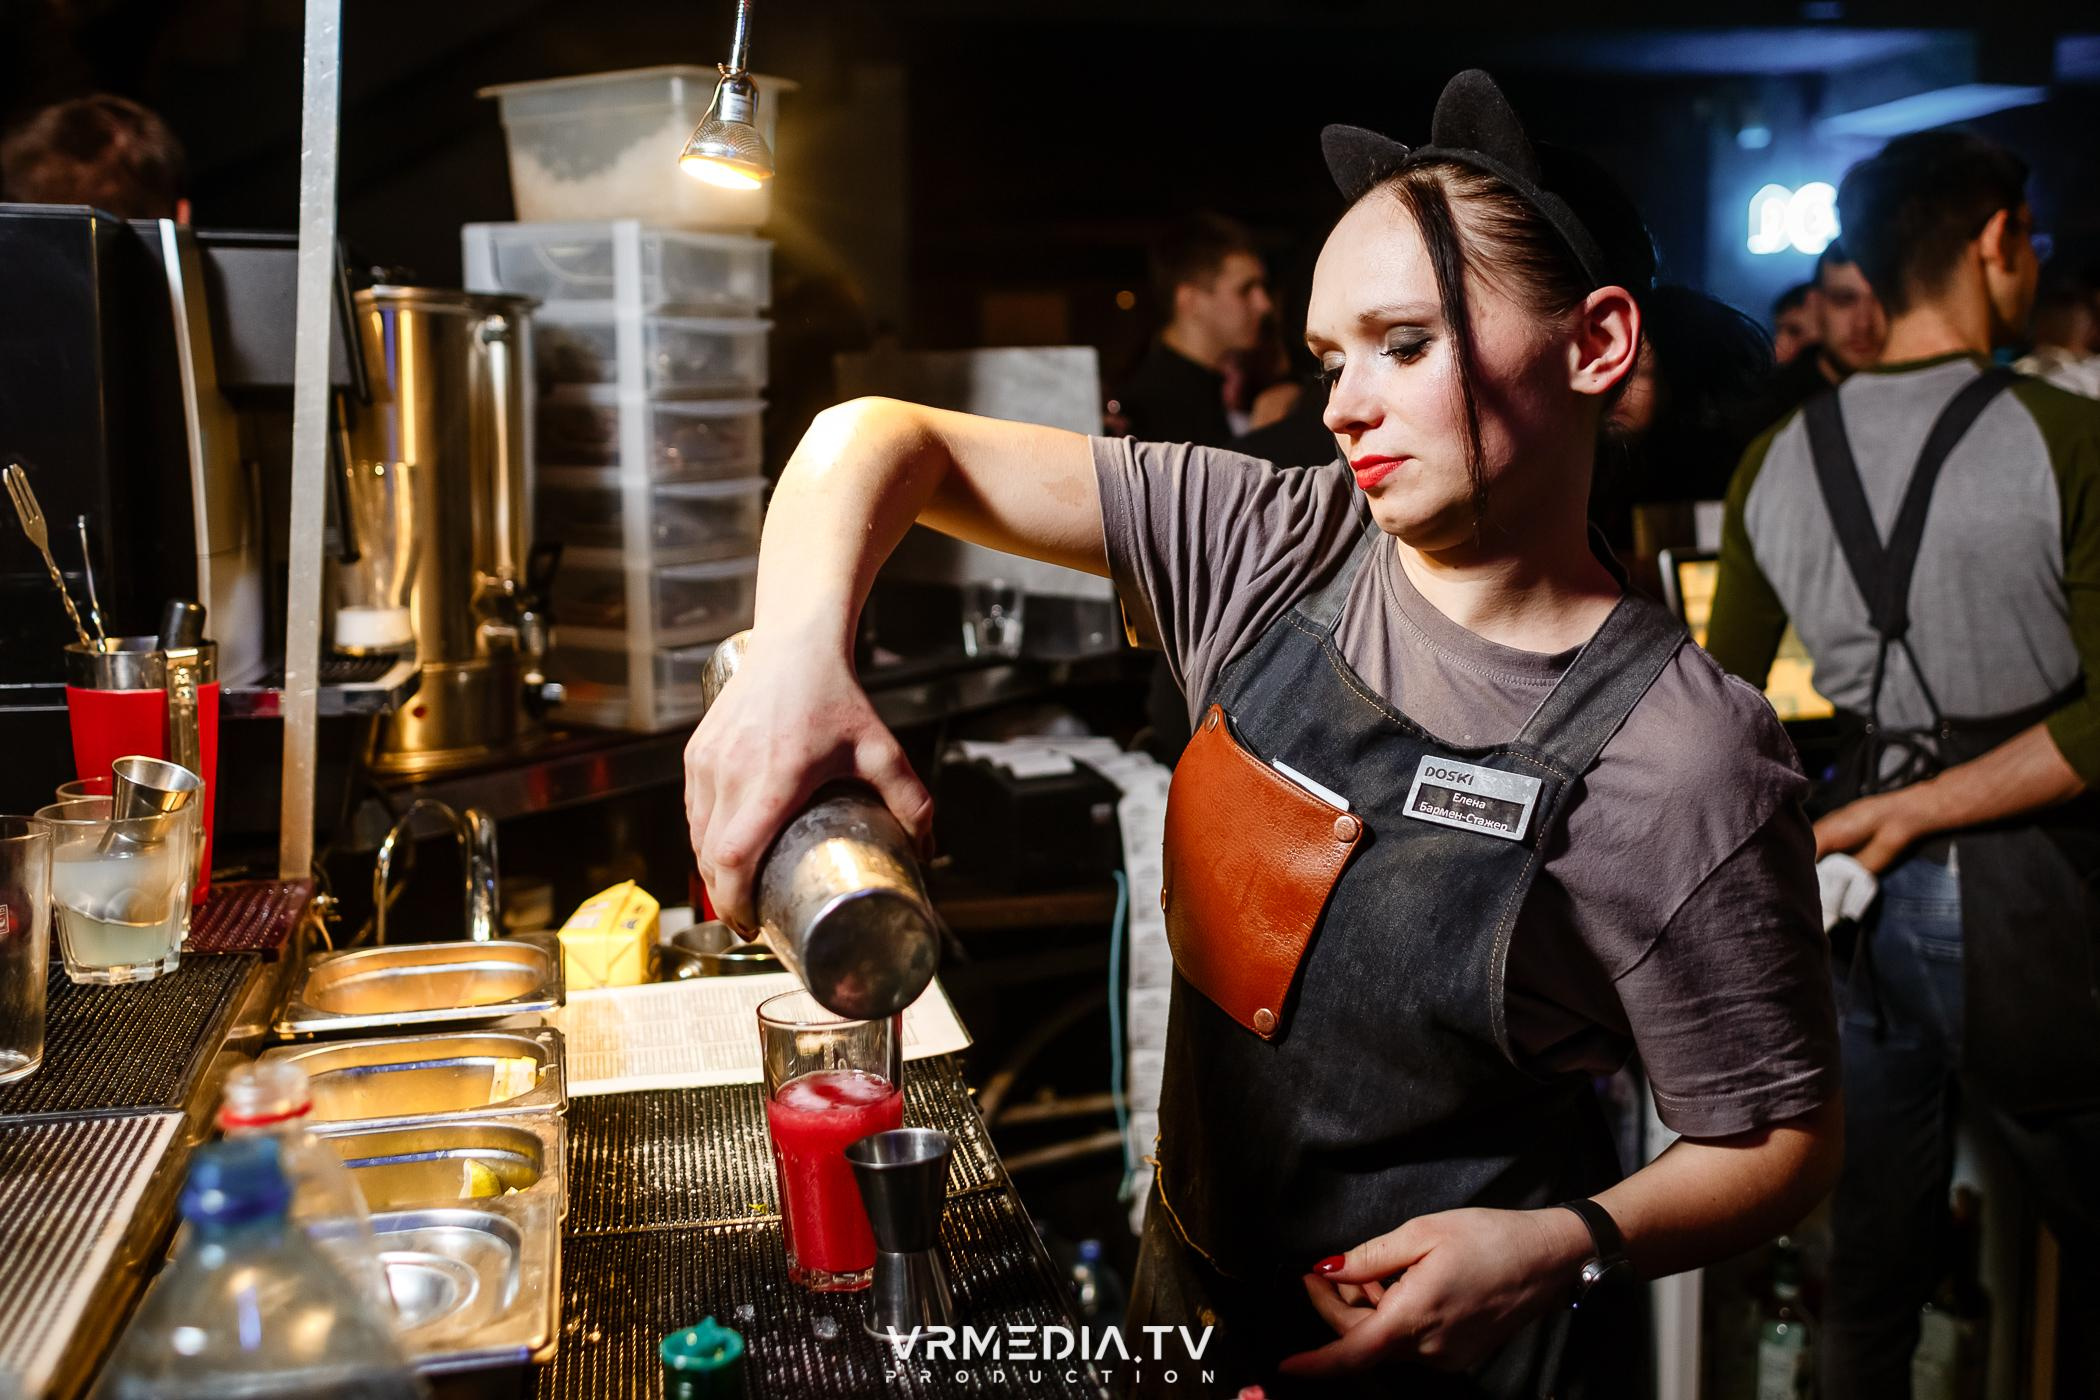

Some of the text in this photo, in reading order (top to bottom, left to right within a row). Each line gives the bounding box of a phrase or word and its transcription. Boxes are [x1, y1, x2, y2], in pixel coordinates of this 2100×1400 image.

[1424, 766, 1474, 786] DOSKI
[1452, 793, 1486, 809] Елена
[1419, 801, 1508, 832] Бармен-Стажер
